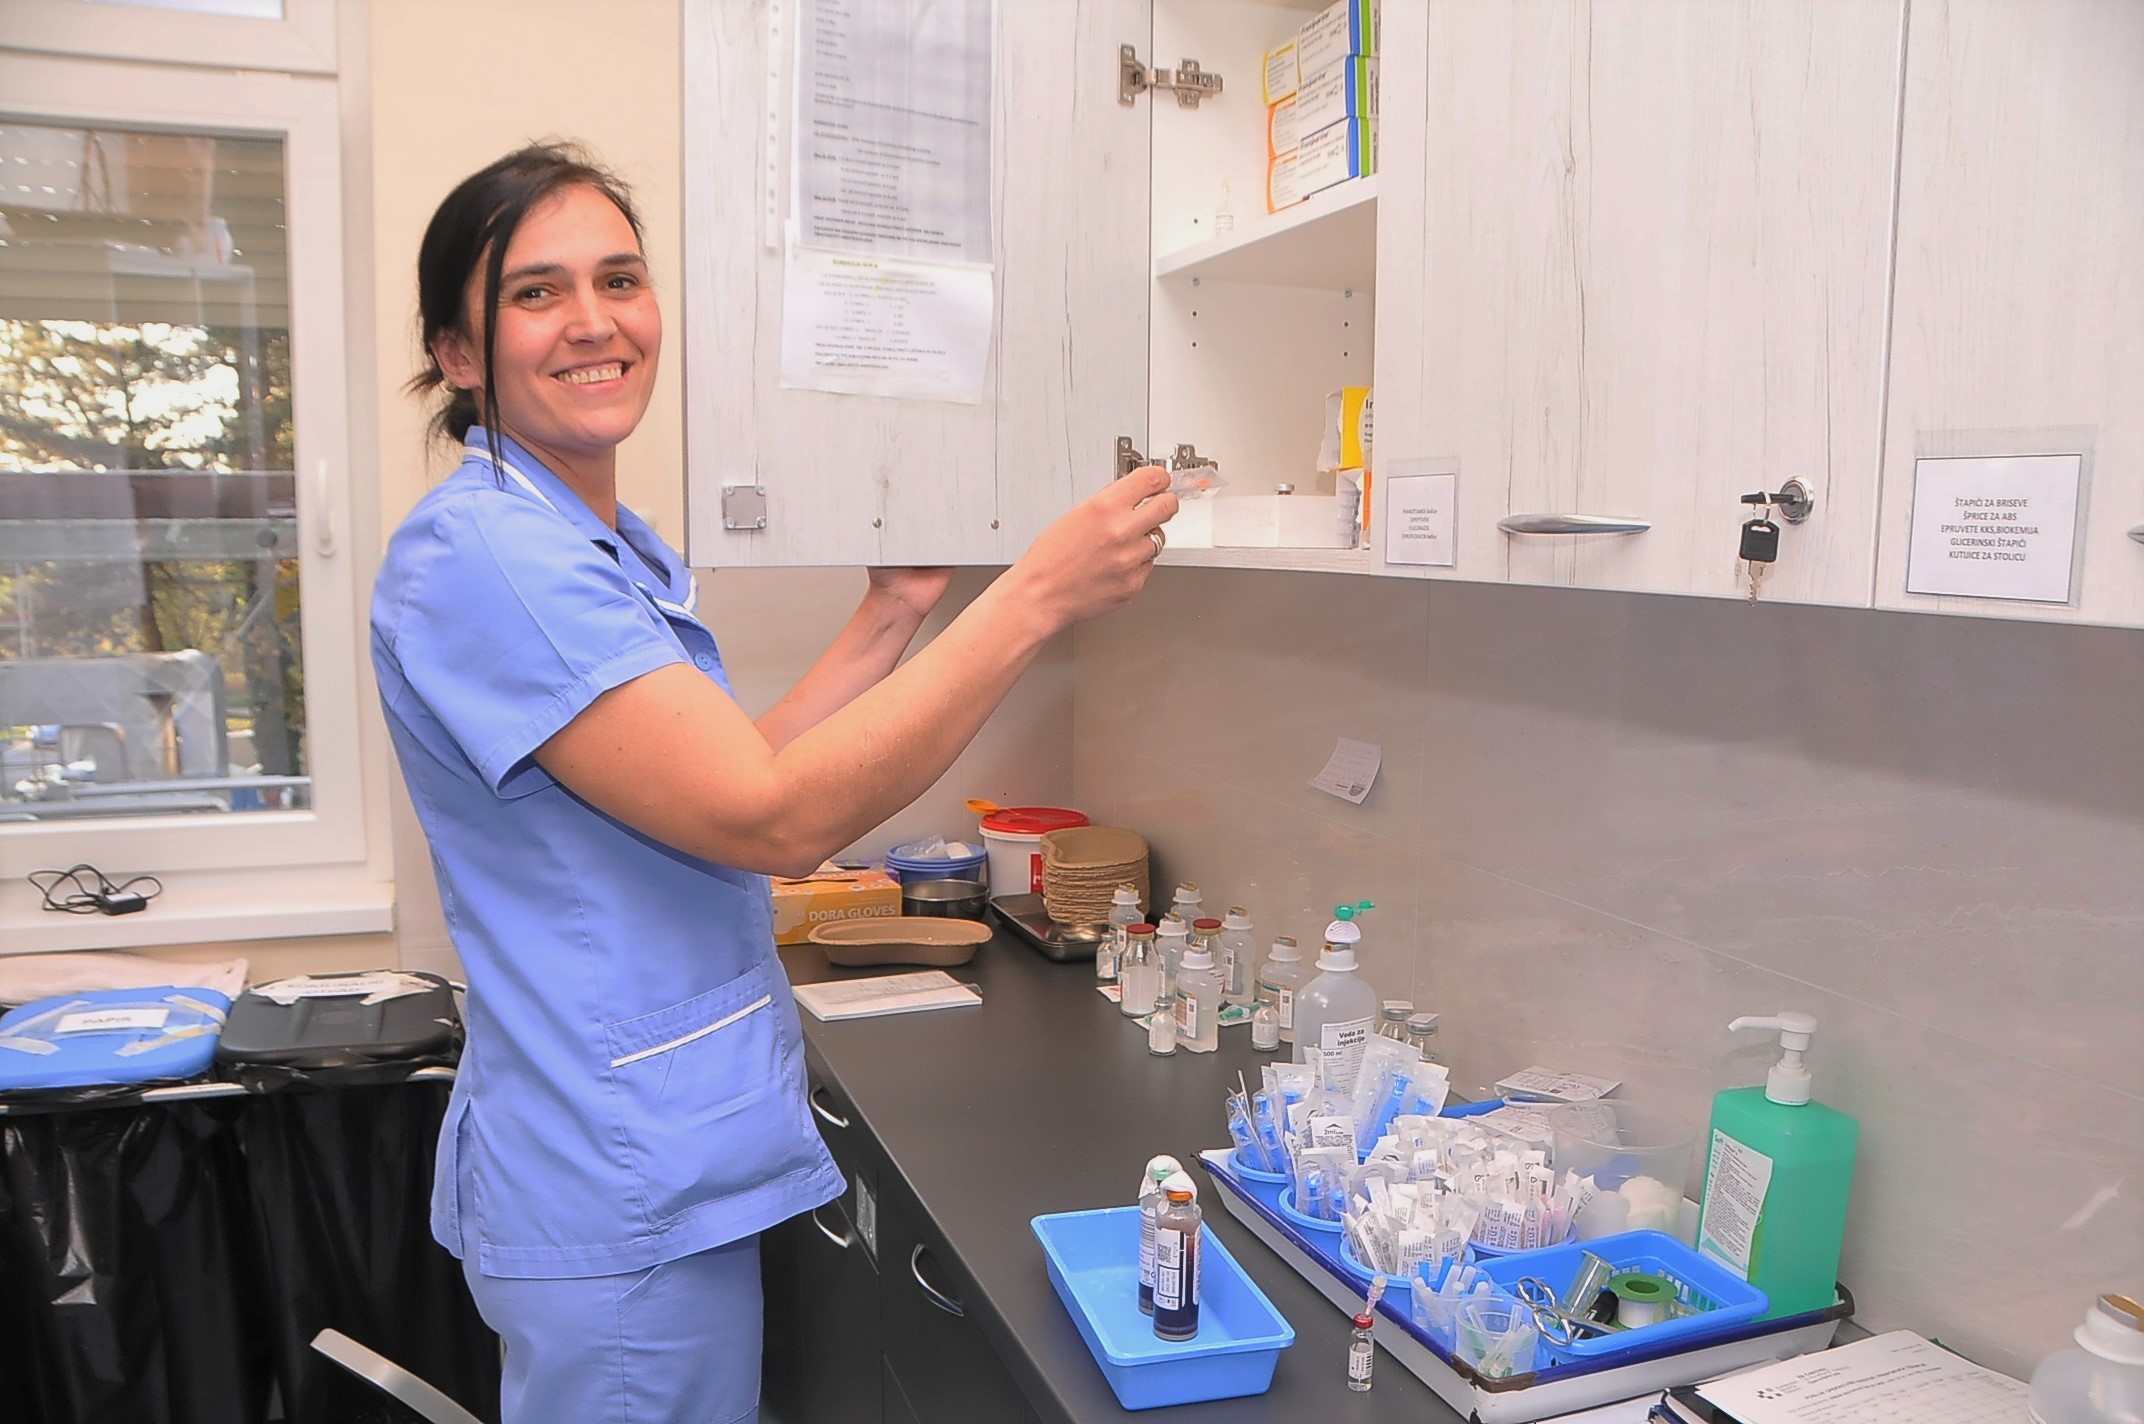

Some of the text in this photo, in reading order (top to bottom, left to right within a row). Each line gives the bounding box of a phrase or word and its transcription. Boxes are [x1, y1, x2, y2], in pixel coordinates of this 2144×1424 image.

[1954, 497, 2028, 508] ŠTAPIĆI ZA BRISEVE
[1963, 510, 2017, 521] ŠPRICE ZA ABS
[1941, 524, 1979, 534] EPRUVETE
[1950, 537, 2026, 548] GLICERINSKI ŠTAPIĆI
[1981, 551, 1992, 560] ZA
[1993, 552, 2026, 562] STOLICU
[809, 905, 896, 921] DORA GLOVES
[1338, 1030, 1356, 1039] Voda
[1337, 1035, 1366, 1047] injekcije
